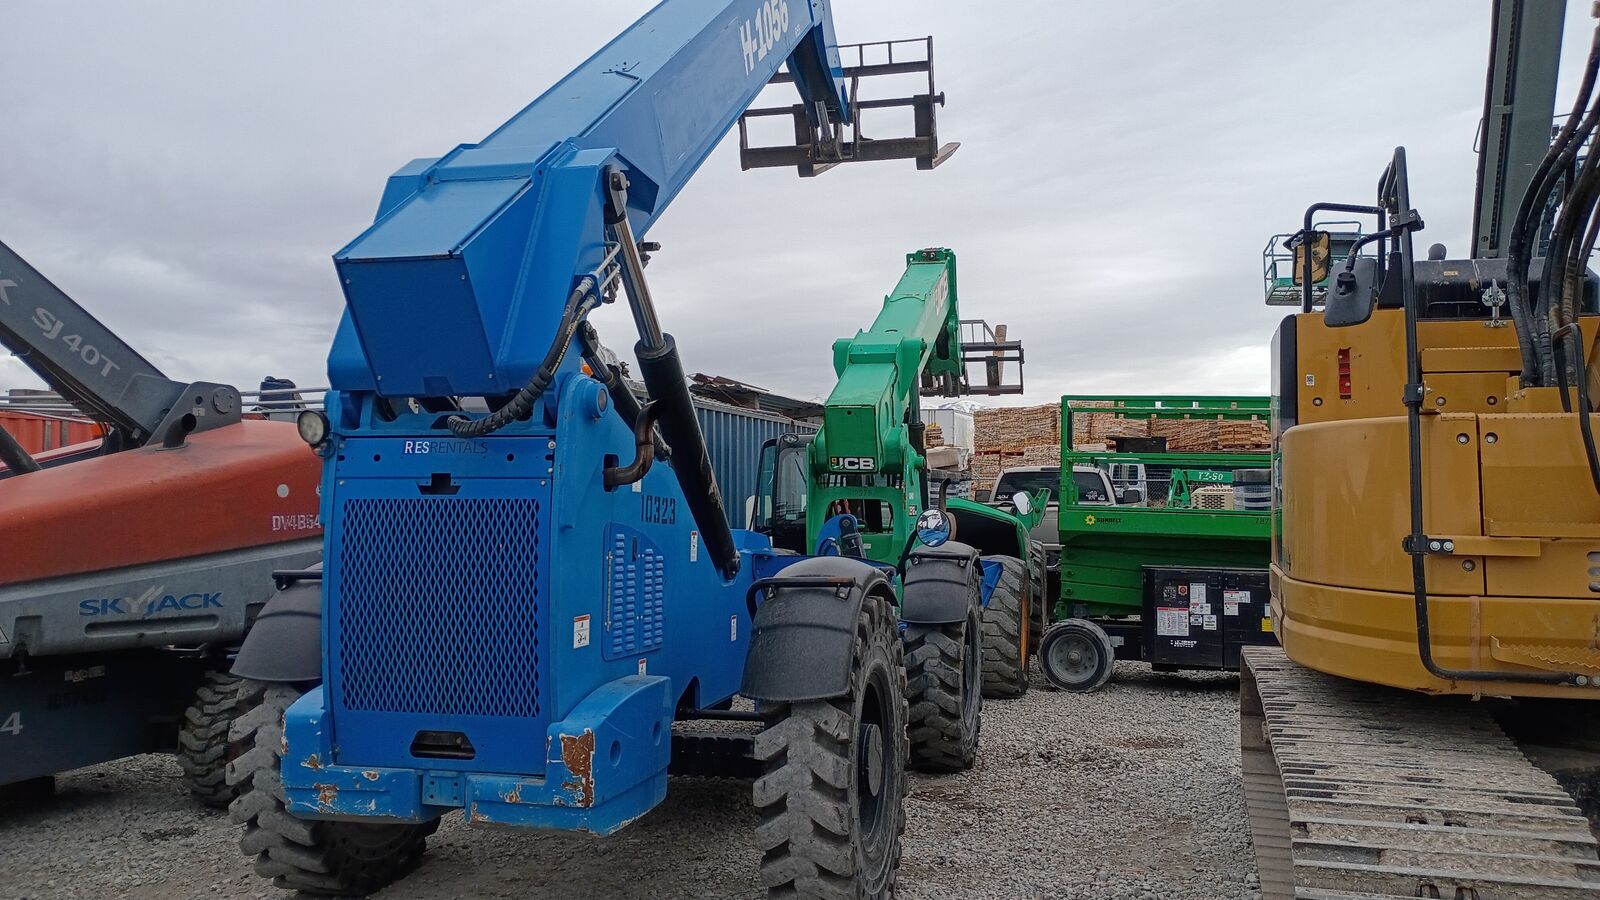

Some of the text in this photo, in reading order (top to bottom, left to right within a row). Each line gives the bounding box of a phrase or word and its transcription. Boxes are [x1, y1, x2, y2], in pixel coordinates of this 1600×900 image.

[740, 0, 789, 76] H-1056
[831, 457, 875, 470] JCB
[641, 494, 676, 525] 10323
[79, 584, 224, 618] SKYJACK
